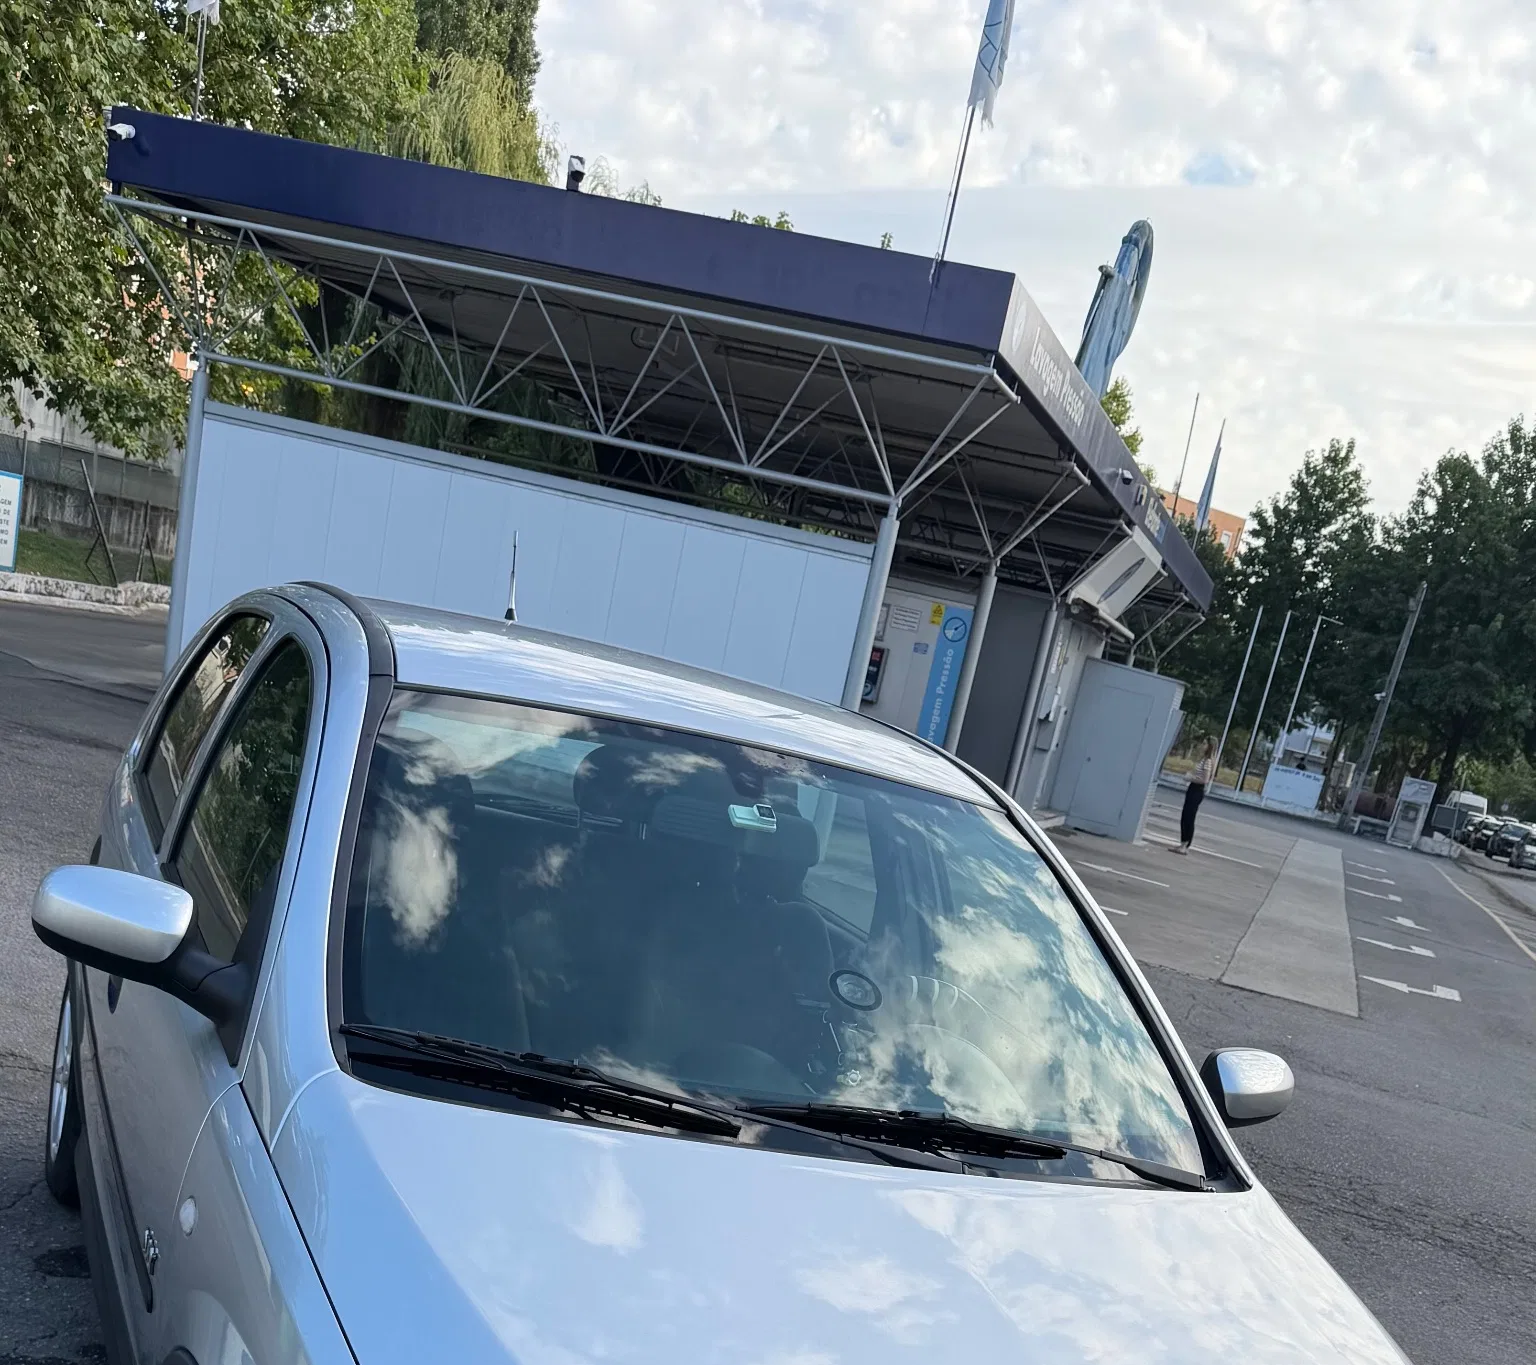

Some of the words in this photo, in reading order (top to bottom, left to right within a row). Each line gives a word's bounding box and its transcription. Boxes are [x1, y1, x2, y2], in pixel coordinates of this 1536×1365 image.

[1029, 326, 1064, 399] Lavagem
[927, 698, 943, 742] vagem
[936, 648, 955, 694] Pressão
